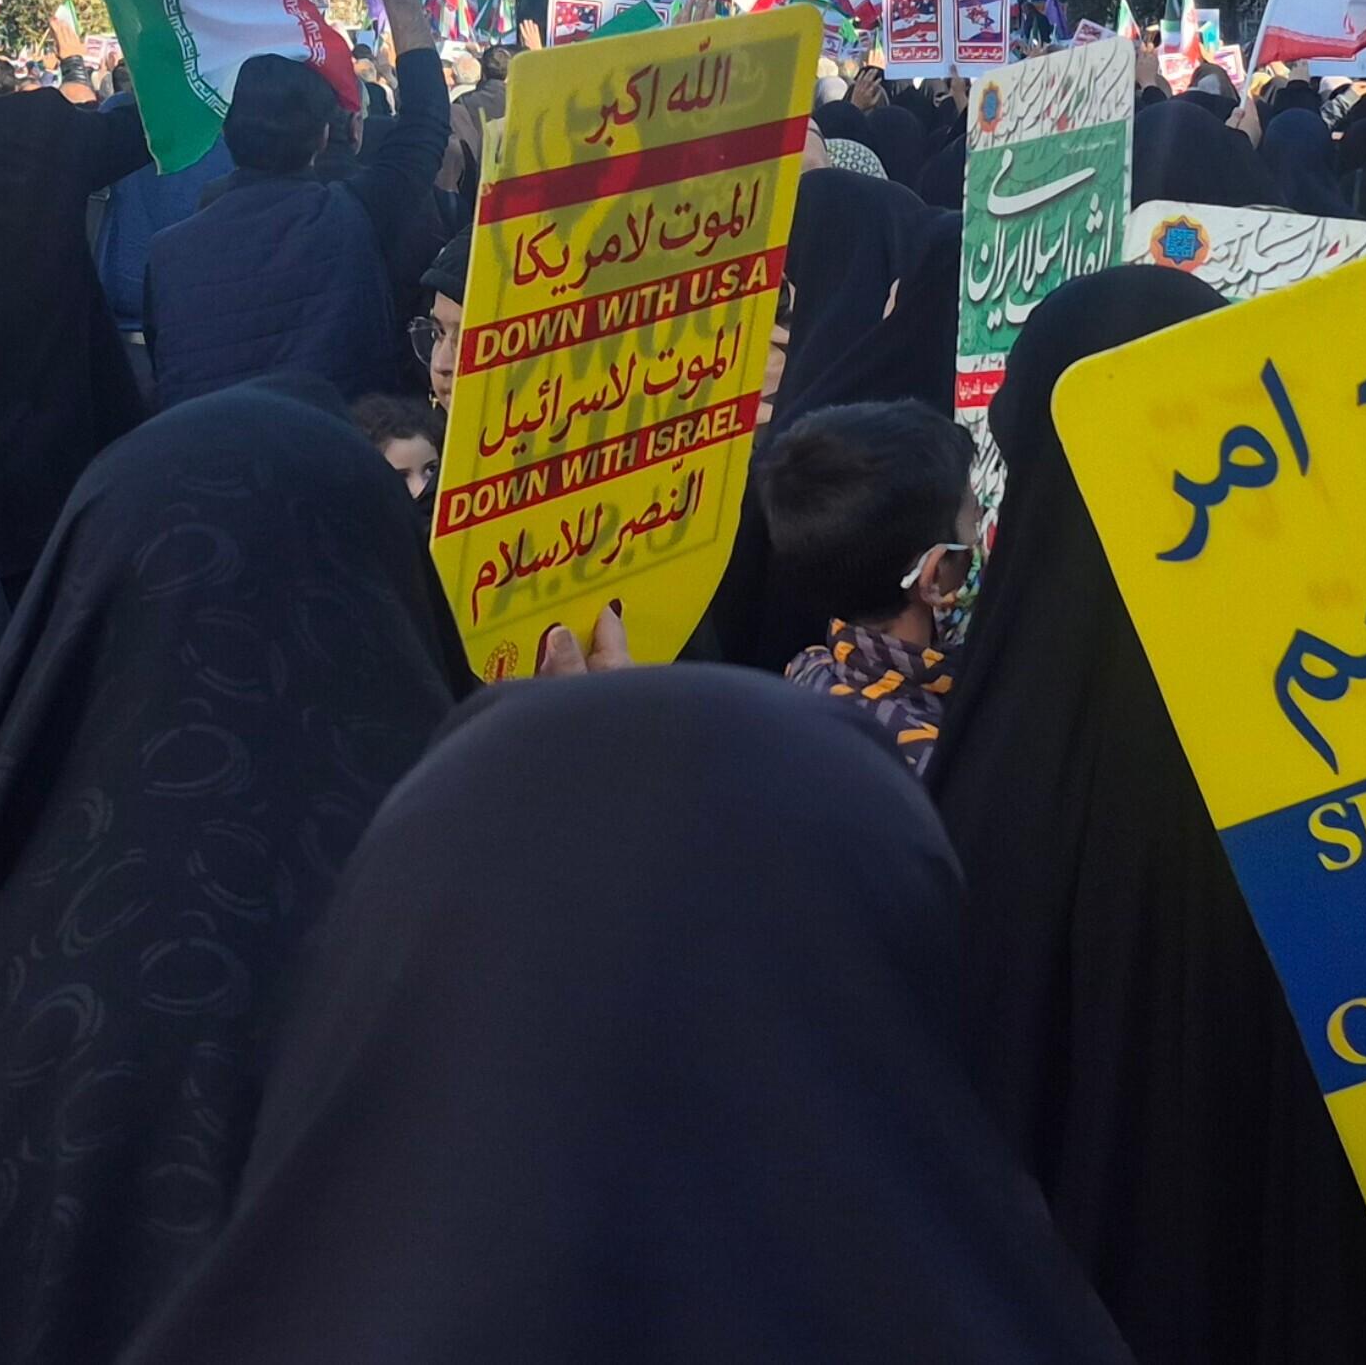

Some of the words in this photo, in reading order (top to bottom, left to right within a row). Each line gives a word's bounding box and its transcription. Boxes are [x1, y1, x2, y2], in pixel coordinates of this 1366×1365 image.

[584, 64, 661, 148] اکبر
[513, 203, 655, 297] لامریکا
[659, 178, 761, 258] الموت
[473, 303, 587, 367] DOWN
[595, 281, 681, 332] WITH
[688, 256, 769, 305] U.S.A
[643, 322, 742, 401] الموت
[479, 352, 637, 457] لاسرائیل
[446, 464, 552, 527] DOWN
[559, 440, 637, 489] WITH
[644, 402, 744, 462] ISRAEL
[1155, 356, 1311, 562] امر
[472, 501, 604, 626] للاسلام
